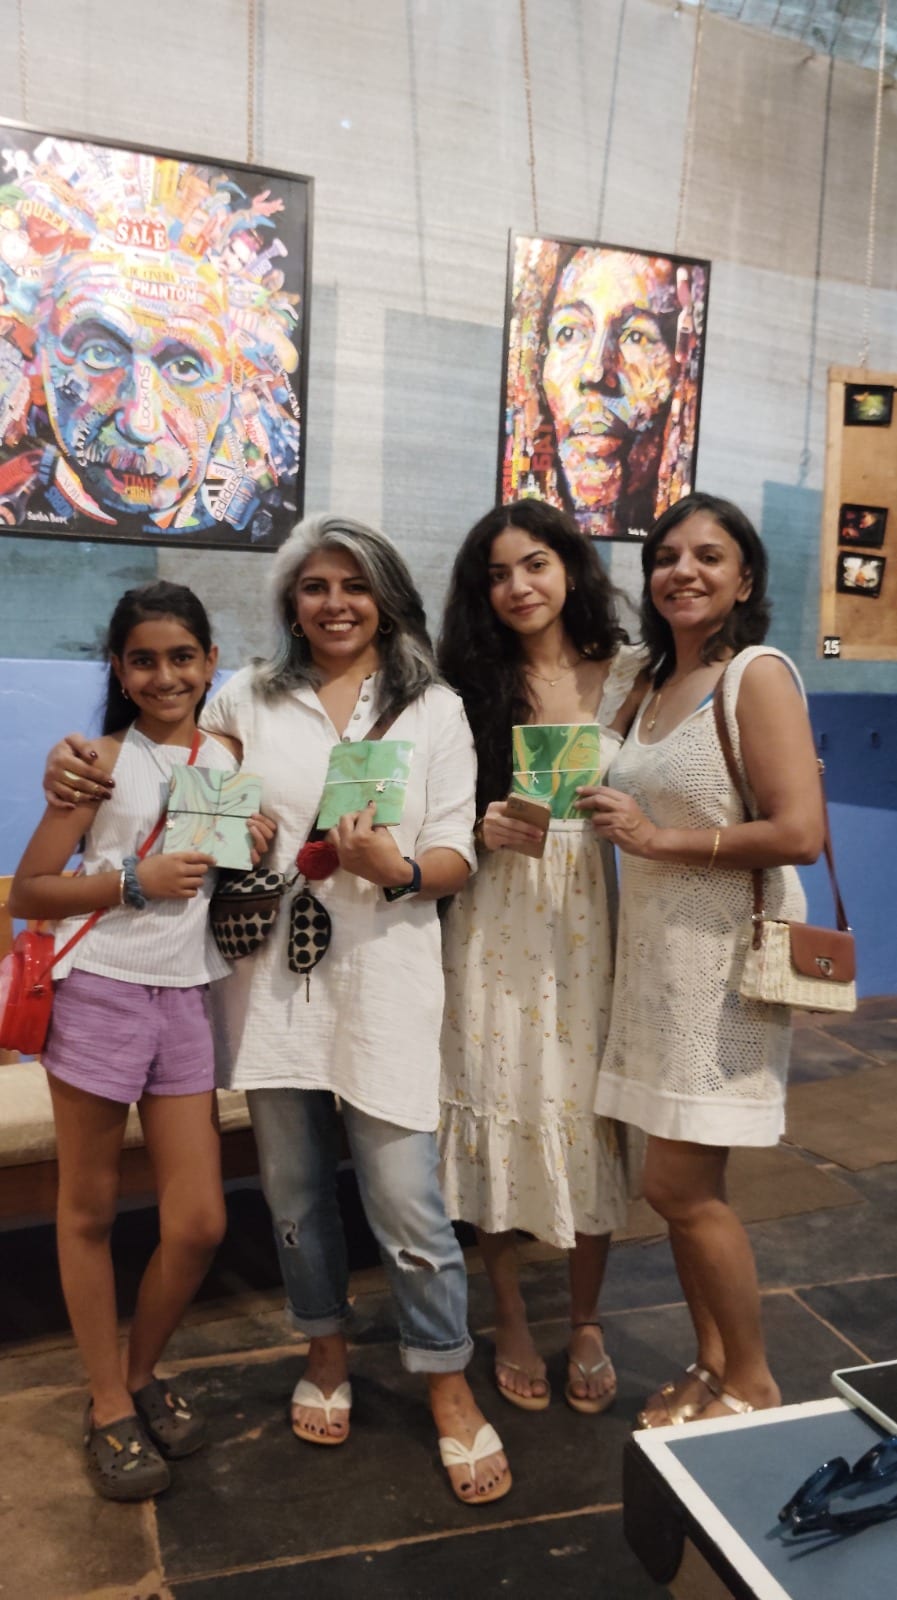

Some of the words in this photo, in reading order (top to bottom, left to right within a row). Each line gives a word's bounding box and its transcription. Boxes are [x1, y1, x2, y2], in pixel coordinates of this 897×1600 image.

[116, 221, 166, 251] SALE
[131, 278, 197, 302] PHANTOM
[214, 475, 241, 518] adidas
[824, 640, 840, 654] 15
